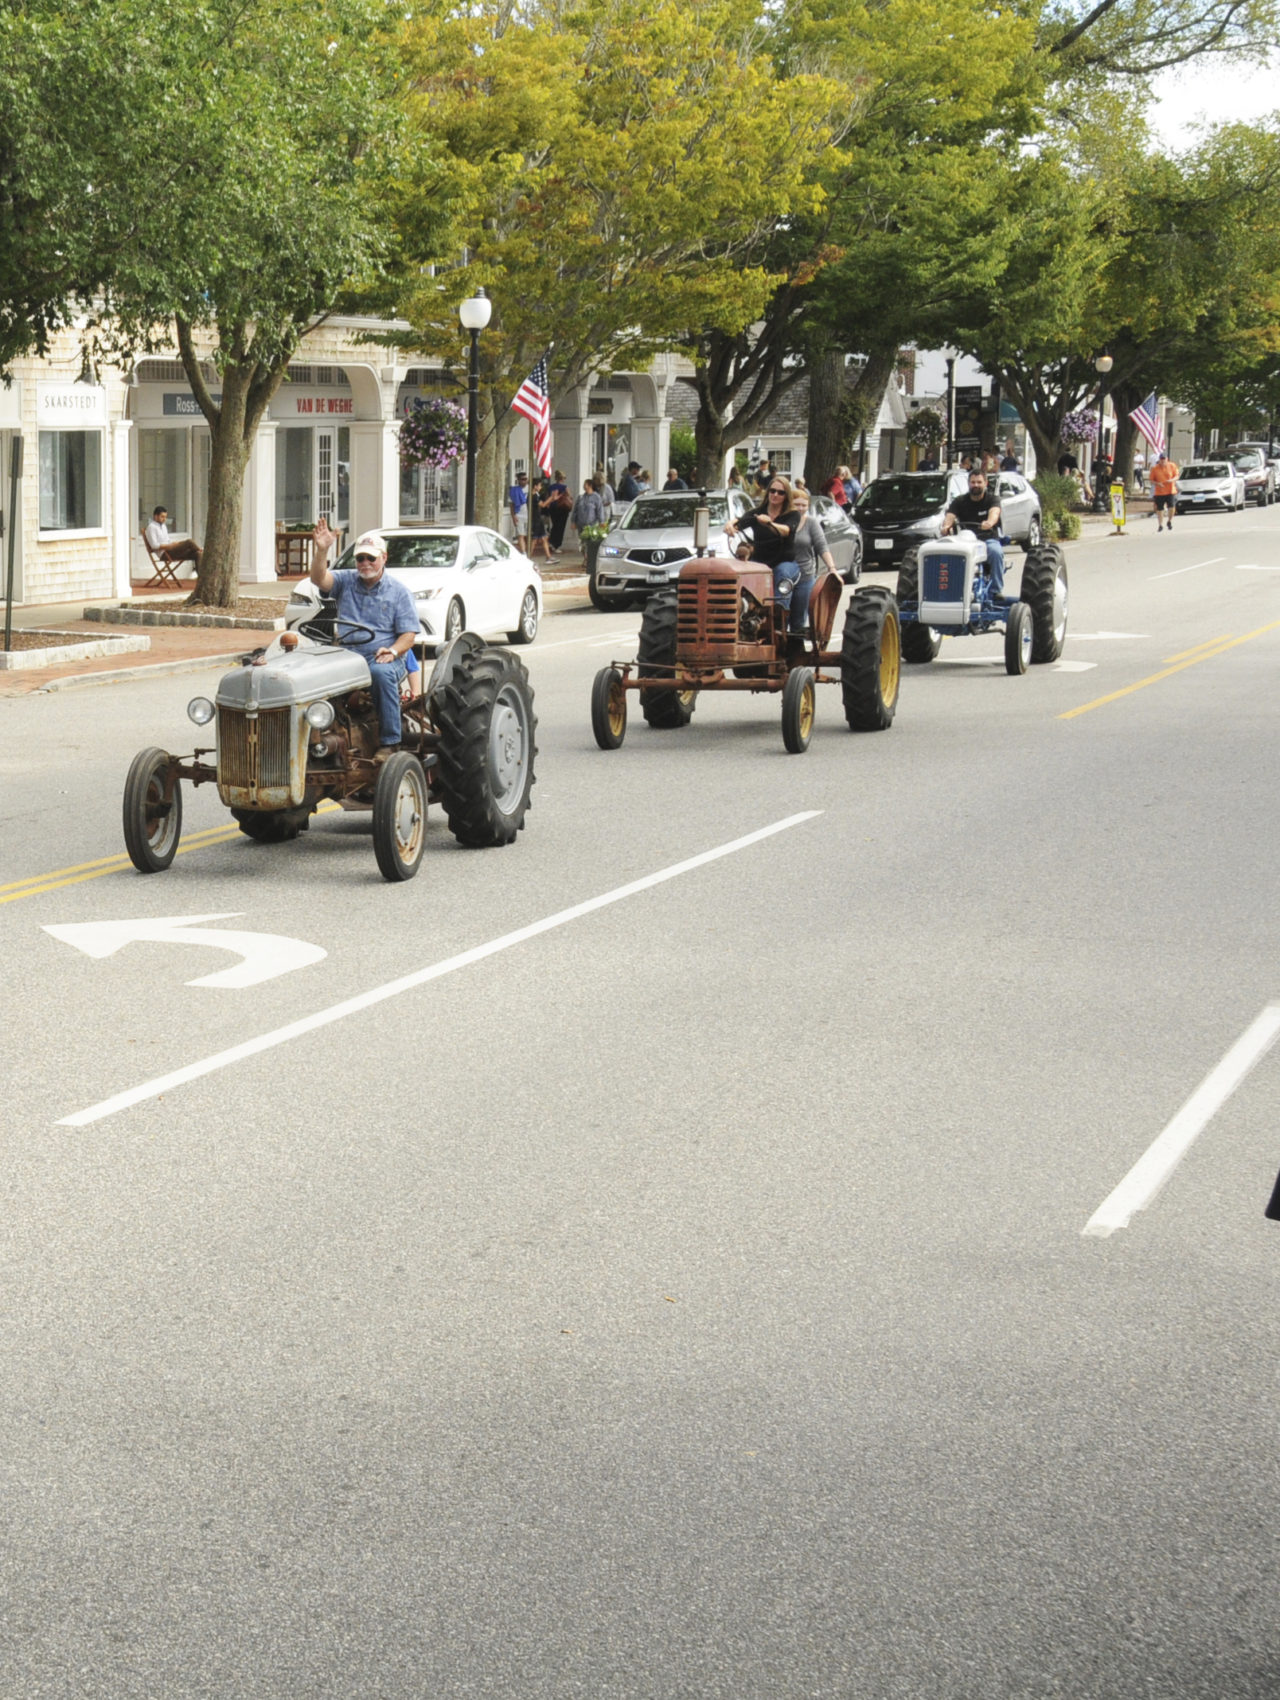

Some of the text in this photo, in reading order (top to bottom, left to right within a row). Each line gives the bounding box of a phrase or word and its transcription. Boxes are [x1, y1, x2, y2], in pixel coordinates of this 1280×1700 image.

[44, 395, 97, 409] SKARSTEDT
[296, 398, 353, 413] VAN DE WEGHE
